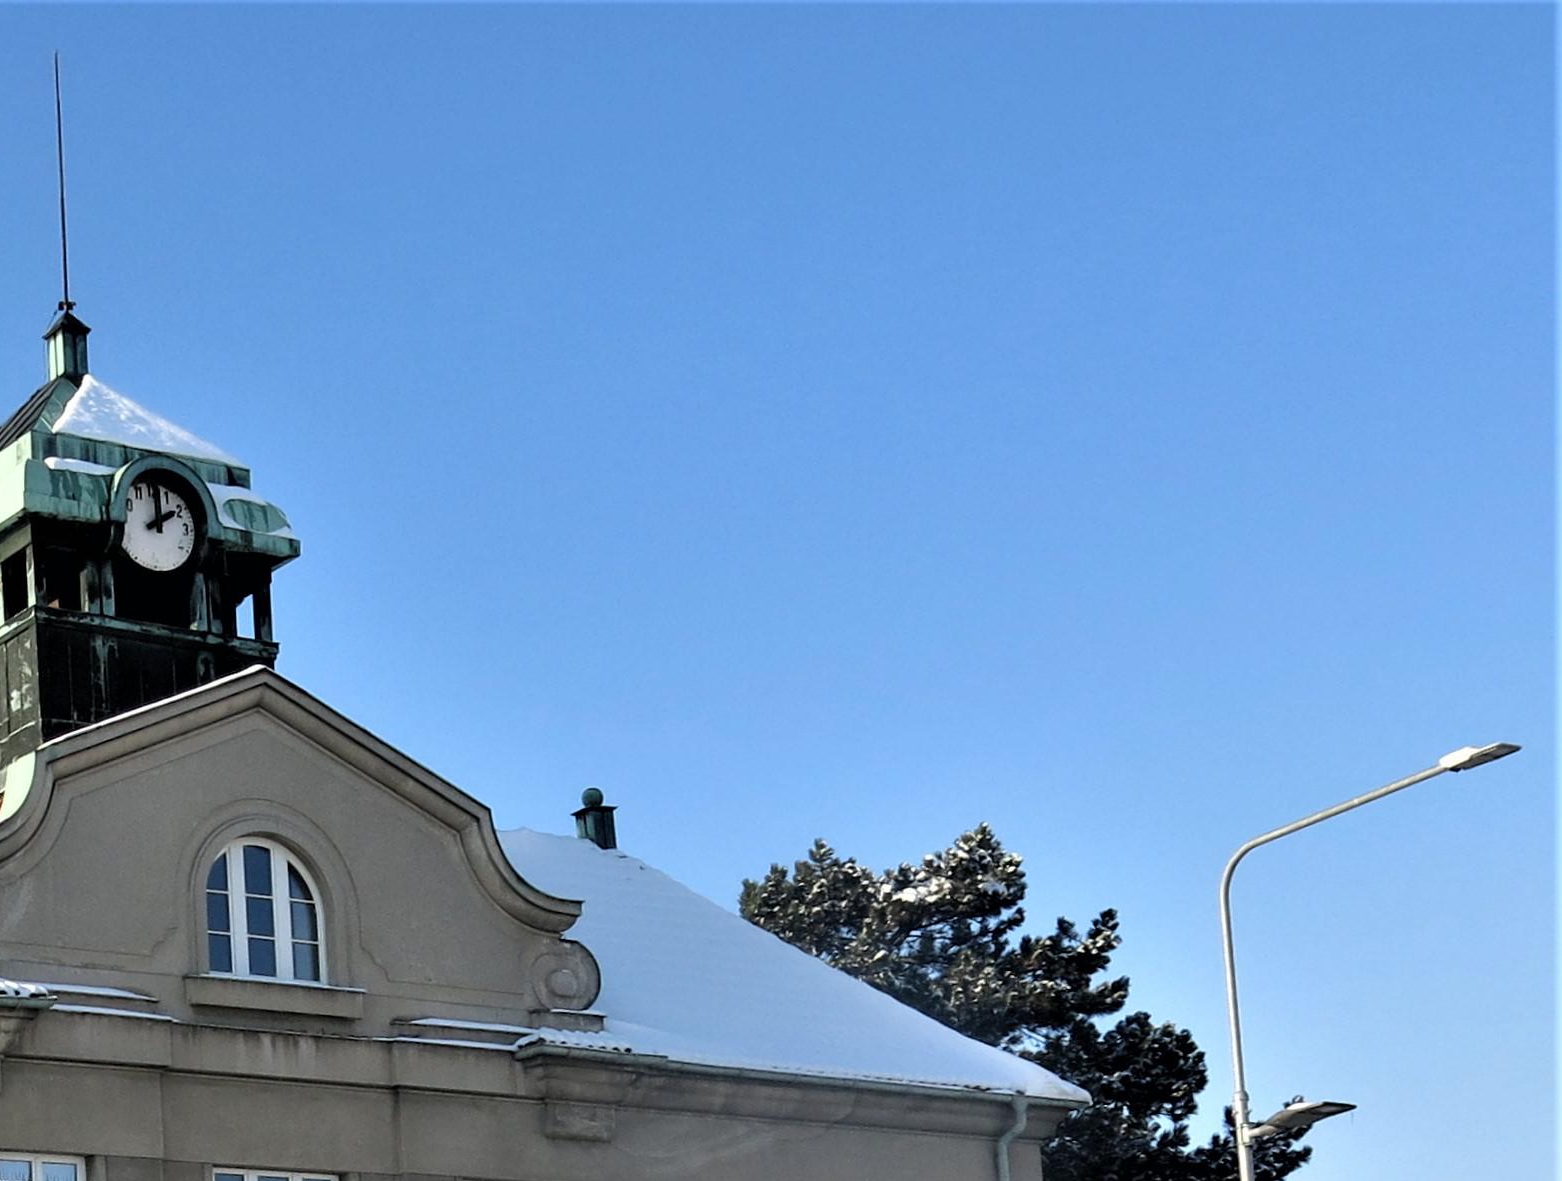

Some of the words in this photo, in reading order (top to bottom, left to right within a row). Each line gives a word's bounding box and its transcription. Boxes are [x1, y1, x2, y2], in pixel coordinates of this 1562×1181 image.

[164, 491, 169, 504] 1
[176, 504, 183, 518] 2
[182, 523, 189, 536] 3
